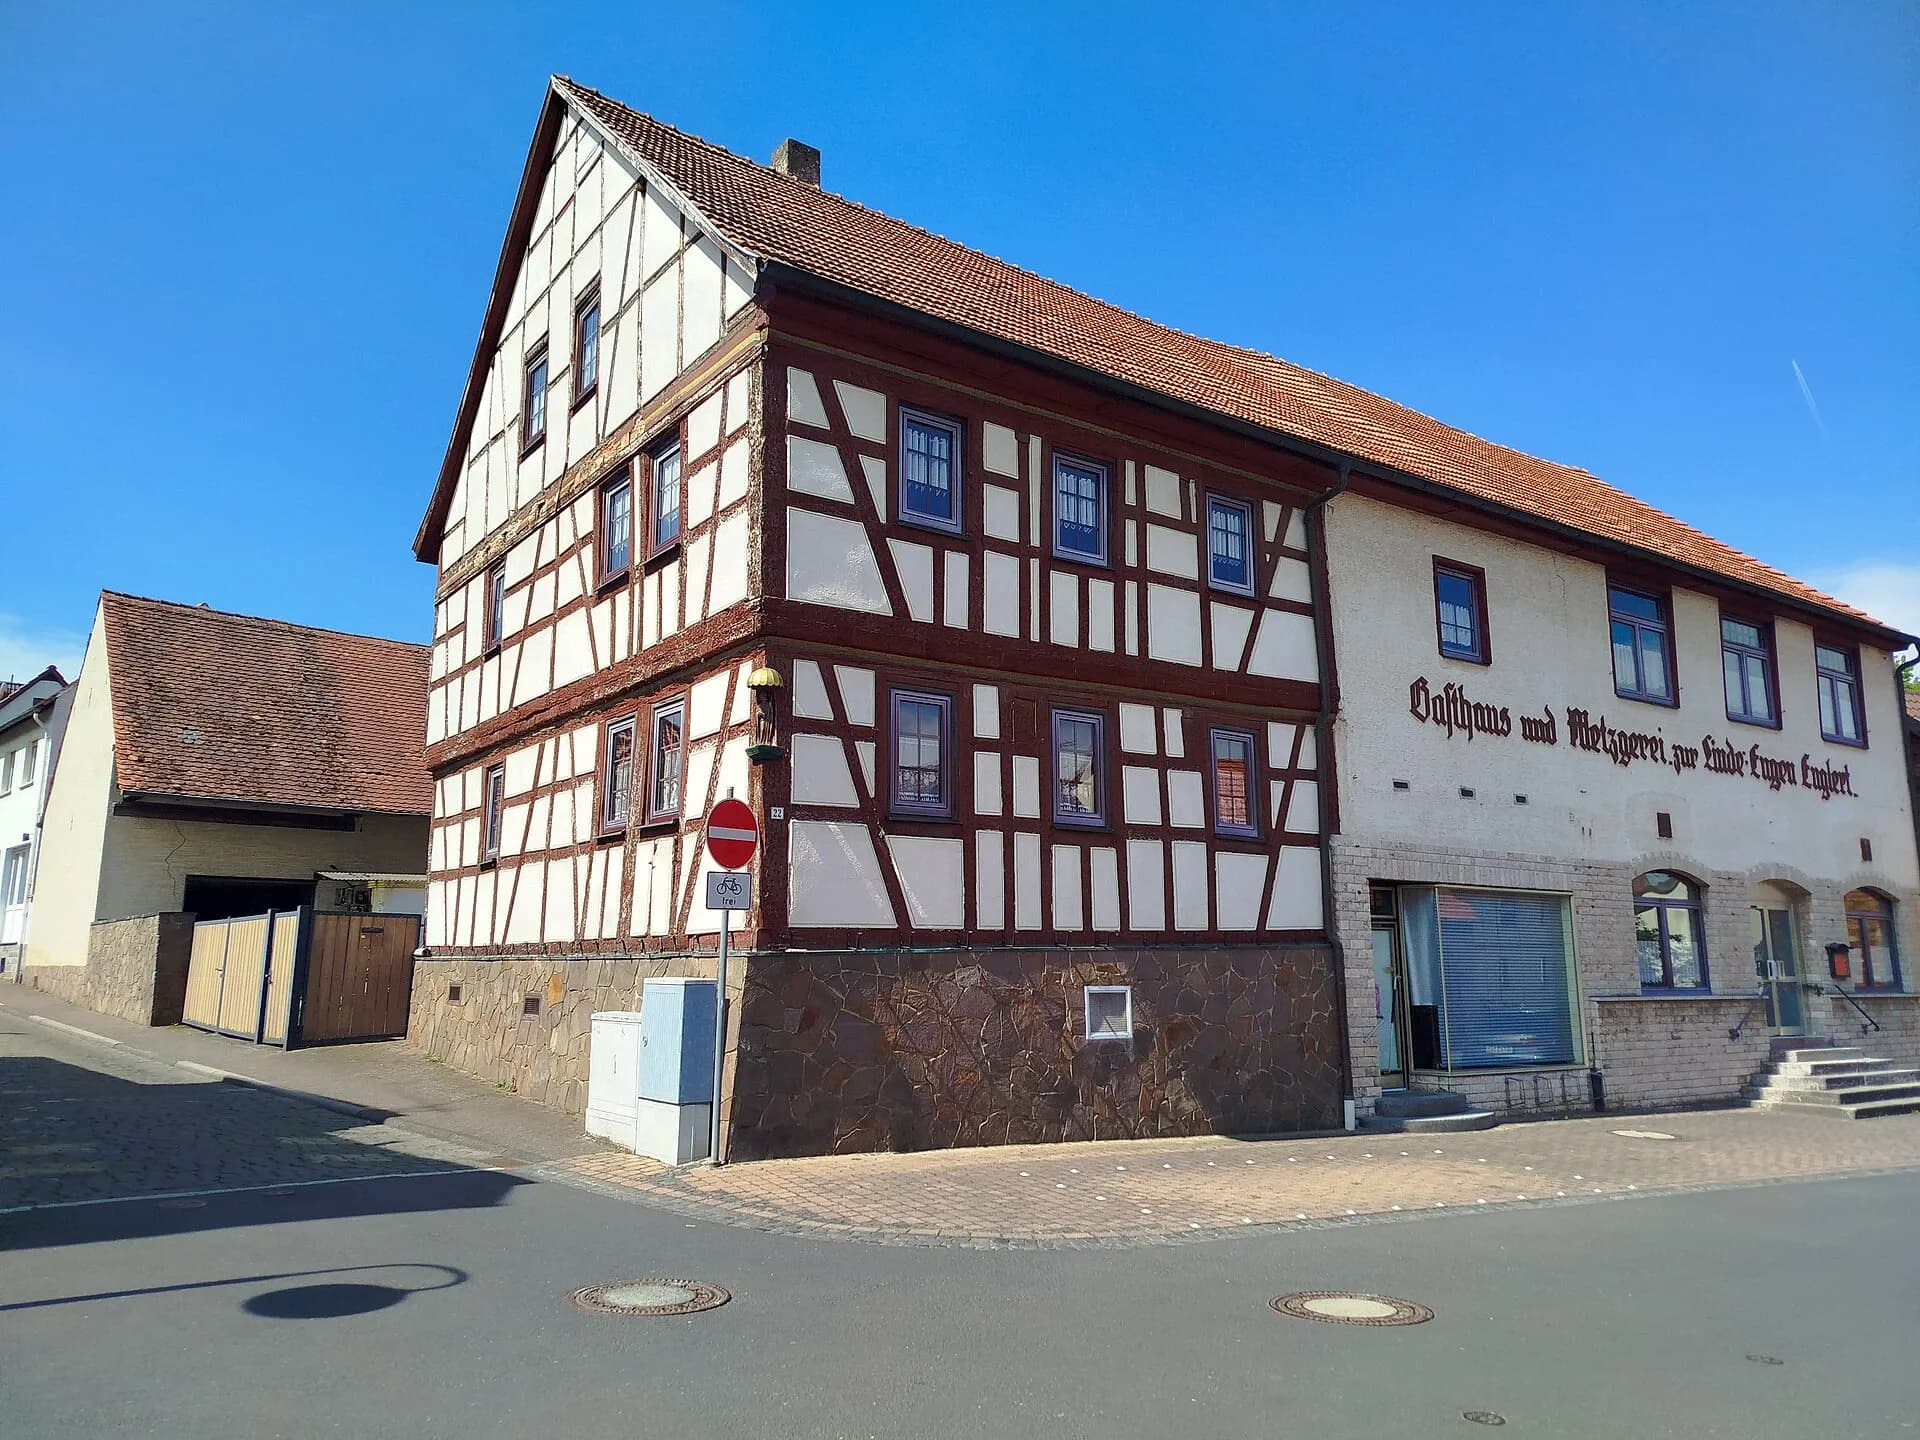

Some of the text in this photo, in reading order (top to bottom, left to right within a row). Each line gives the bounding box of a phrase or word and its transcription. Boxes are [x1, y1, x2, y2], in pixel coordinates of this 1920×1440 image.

[1519, 704, 1557, 745] und
[1672, 744, 1698, 776] zur
[1750, 743, 1797, 791] Eugen
[772, 807, 782, 816] 22
[722, 897, 736, 906] frei
